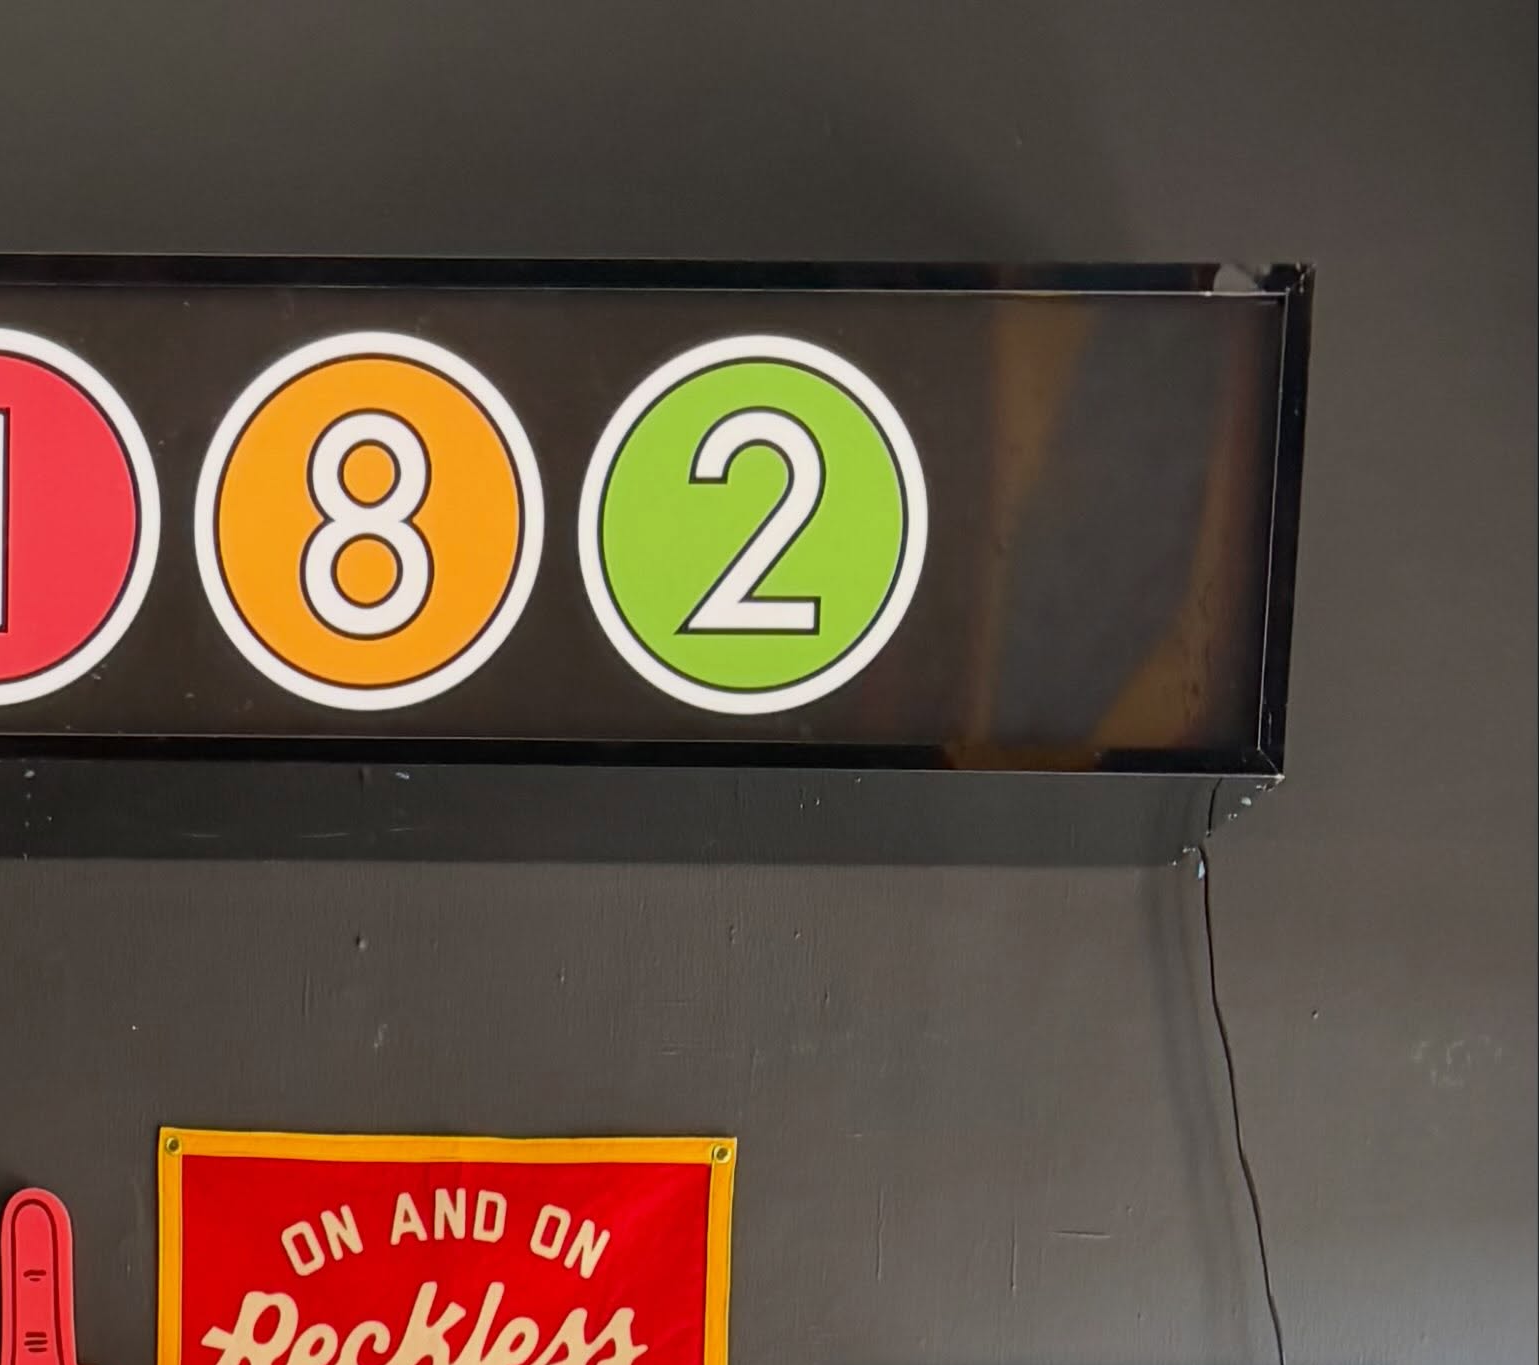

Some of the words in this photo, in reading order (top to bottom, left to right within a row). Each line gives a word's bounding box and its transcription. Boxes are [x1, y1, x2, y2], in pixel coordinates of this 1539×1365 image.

[280, 1204, 364, 1277] ON
[389, 1187, 507, 1246] AND
[529, 1203, 611, 1279] ON
